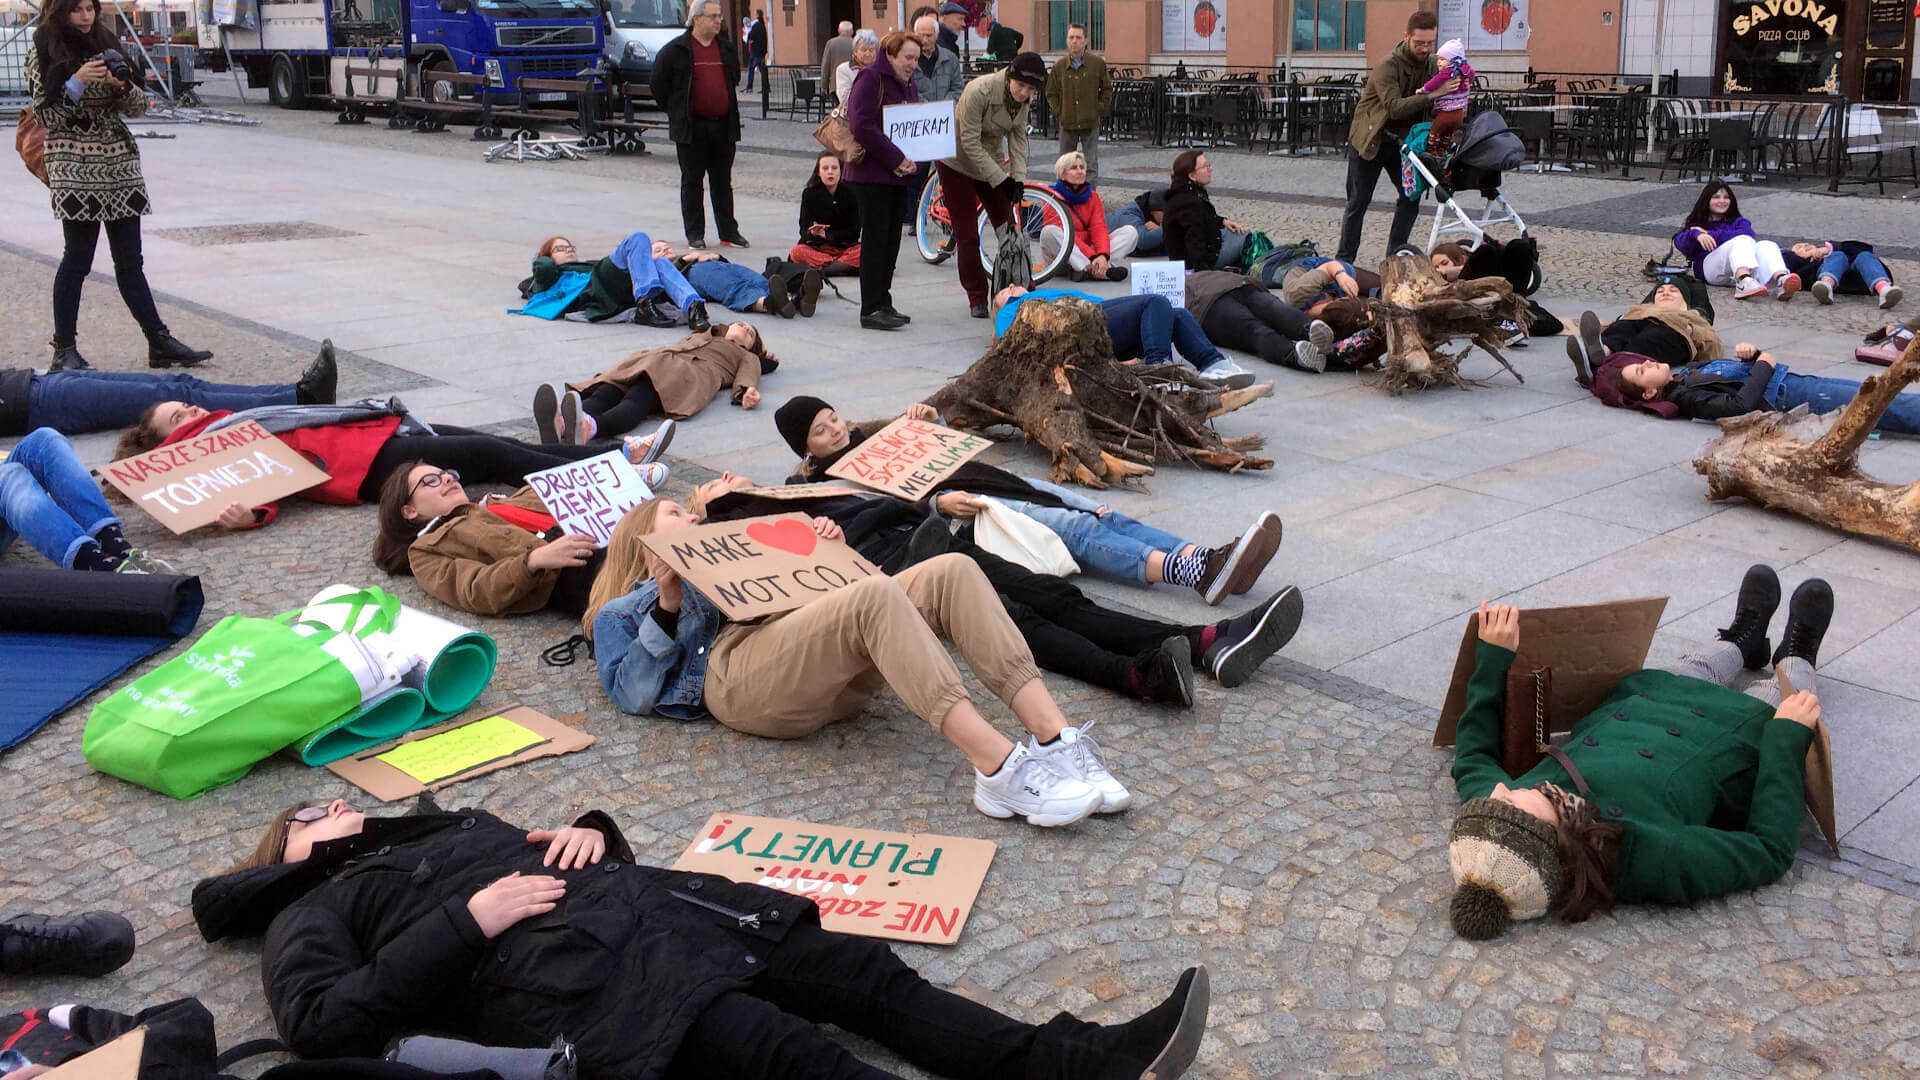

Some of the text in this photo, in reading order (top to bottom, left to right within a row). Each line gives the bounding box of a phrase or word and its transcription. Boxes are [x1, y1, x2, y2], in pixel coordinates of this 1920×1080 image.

[1732, 0, 1838, 36] SAVONA
[1758, 30, 1811, 41] PIZZA CLUB
[890, 117, 949, 141] POPIERAM
[110, 423, 272, 486] NASZE SZANSE
[839, 422, 935, 478] ZMIEŃCIE
[898, 434, 985, 496] NIE KLIMAT
[141, 451, 294, 513] TOPNIEJĄ
[530, 459, 621, 498] DRUGIEJ
[547, 486, 611, 522] ZIEMI
[670, 533, 763, 570] MAKE
[714, 575, 791, 607] NOT
[1024, 785, 1040, 797] FILA
[695, 818, 942, 876] PLANETY!
[757, 866, 867, 896] NAM
[883, 901, 960, 937] NIE
